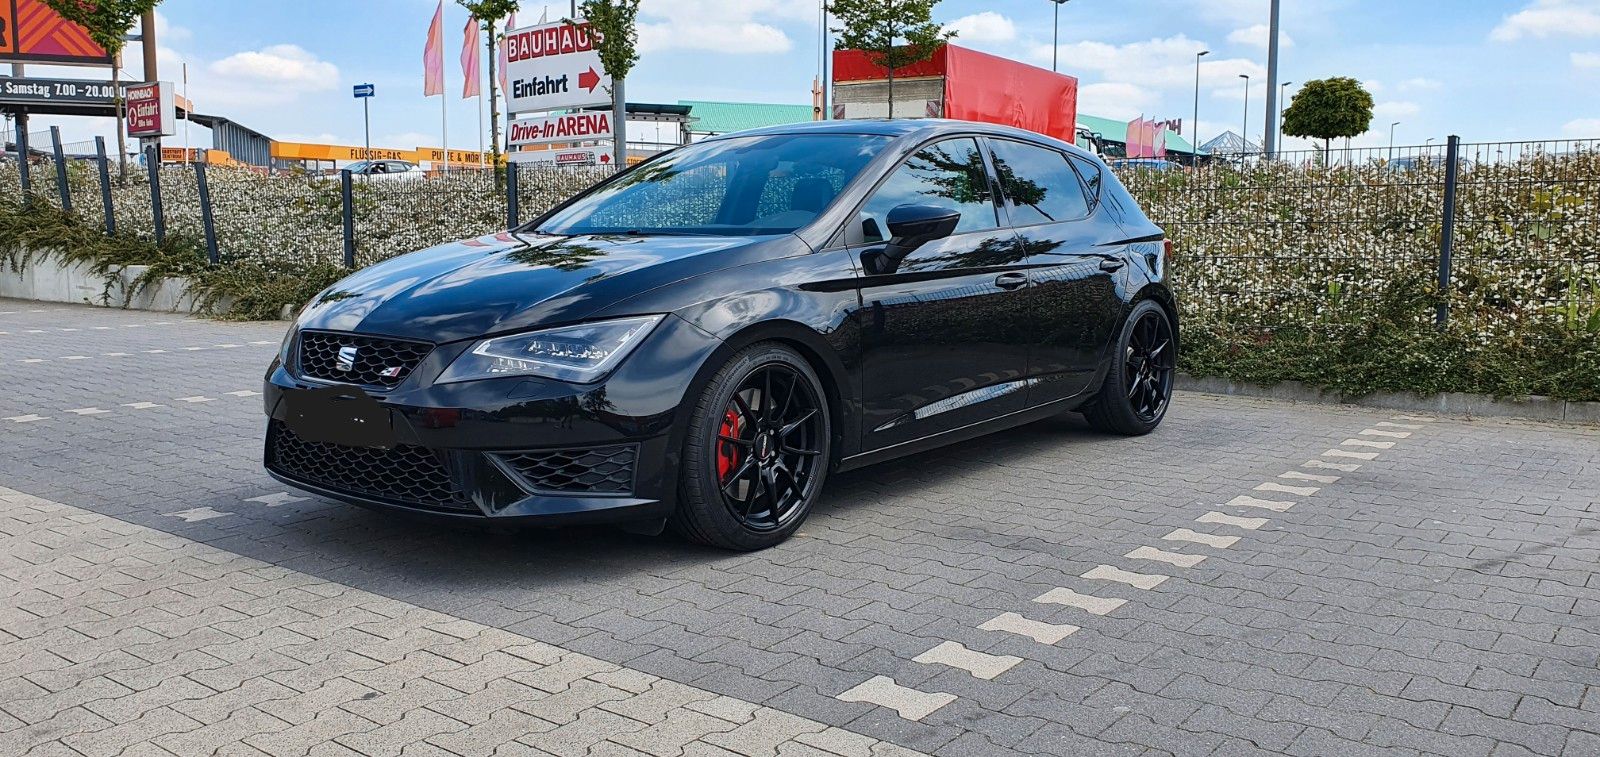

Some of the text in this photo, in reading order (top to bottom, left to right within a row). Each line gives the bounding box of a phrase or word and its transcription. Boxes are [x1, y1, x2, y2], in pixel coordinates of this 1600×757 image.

[508, 27, 605, 58] BAUHAUS
[5, 81, 51, 98] Samstag
[513, 74, 568, 99] Einfahrt
[511, 113, 610, 142] Drive-In ARENA
[465, 151, 490, 164] MÖREL
